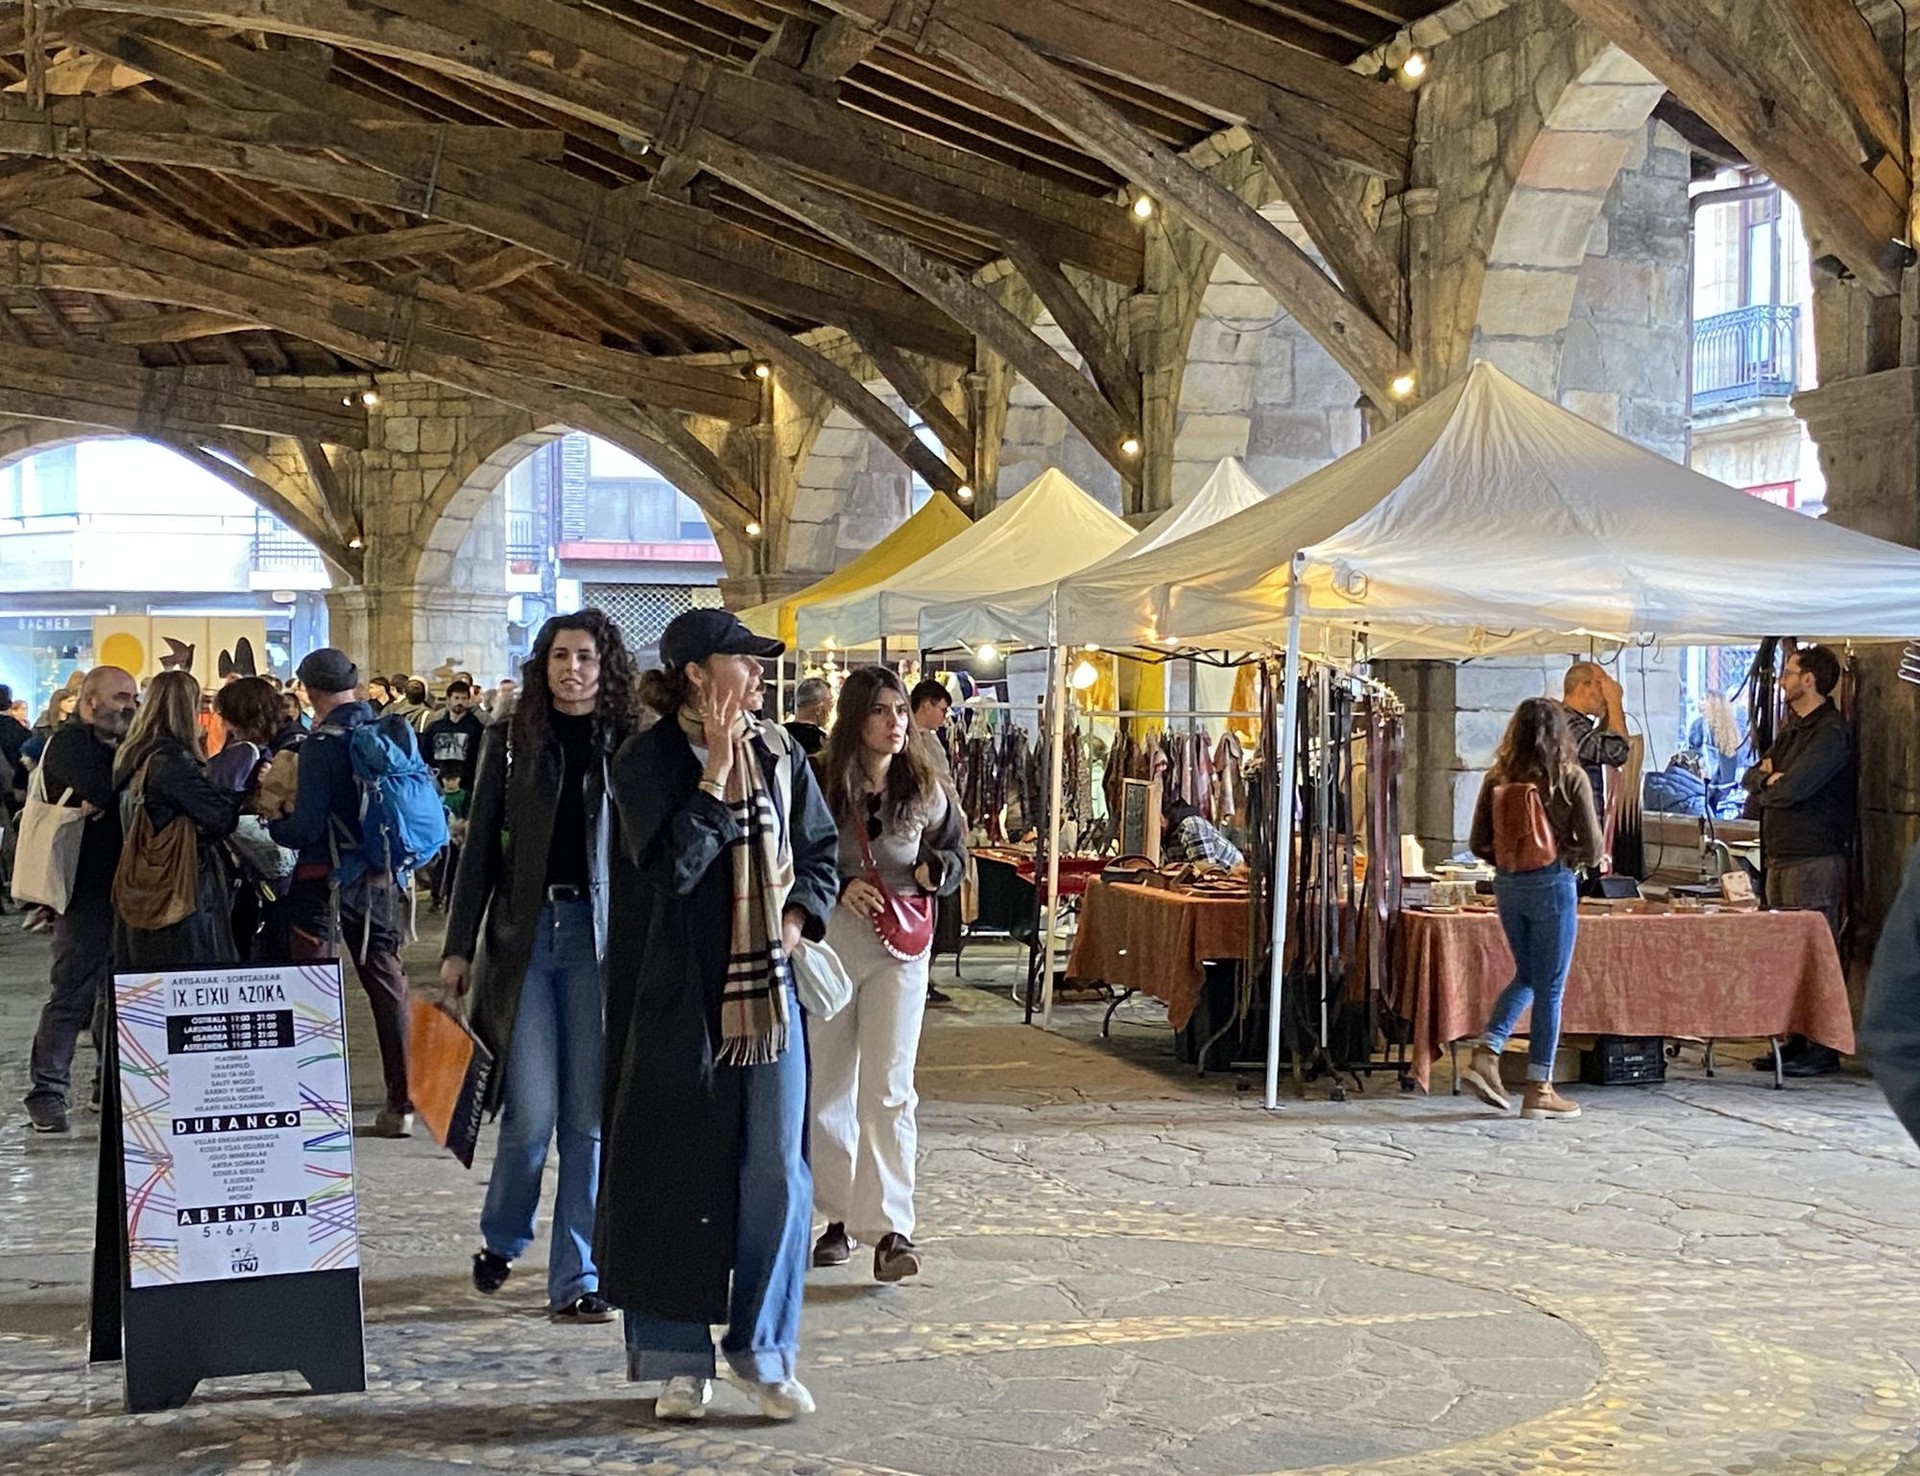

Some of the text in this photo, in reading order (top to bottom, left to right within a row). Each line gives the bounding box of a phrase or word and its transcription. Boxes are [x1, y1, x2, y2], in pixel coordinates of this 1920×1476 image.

[238, 984, 286, 1004] AZOKA
[176, 1115, 298, 1133] DURANGO
[180, 1202, 302, 1224] ABENDUA
